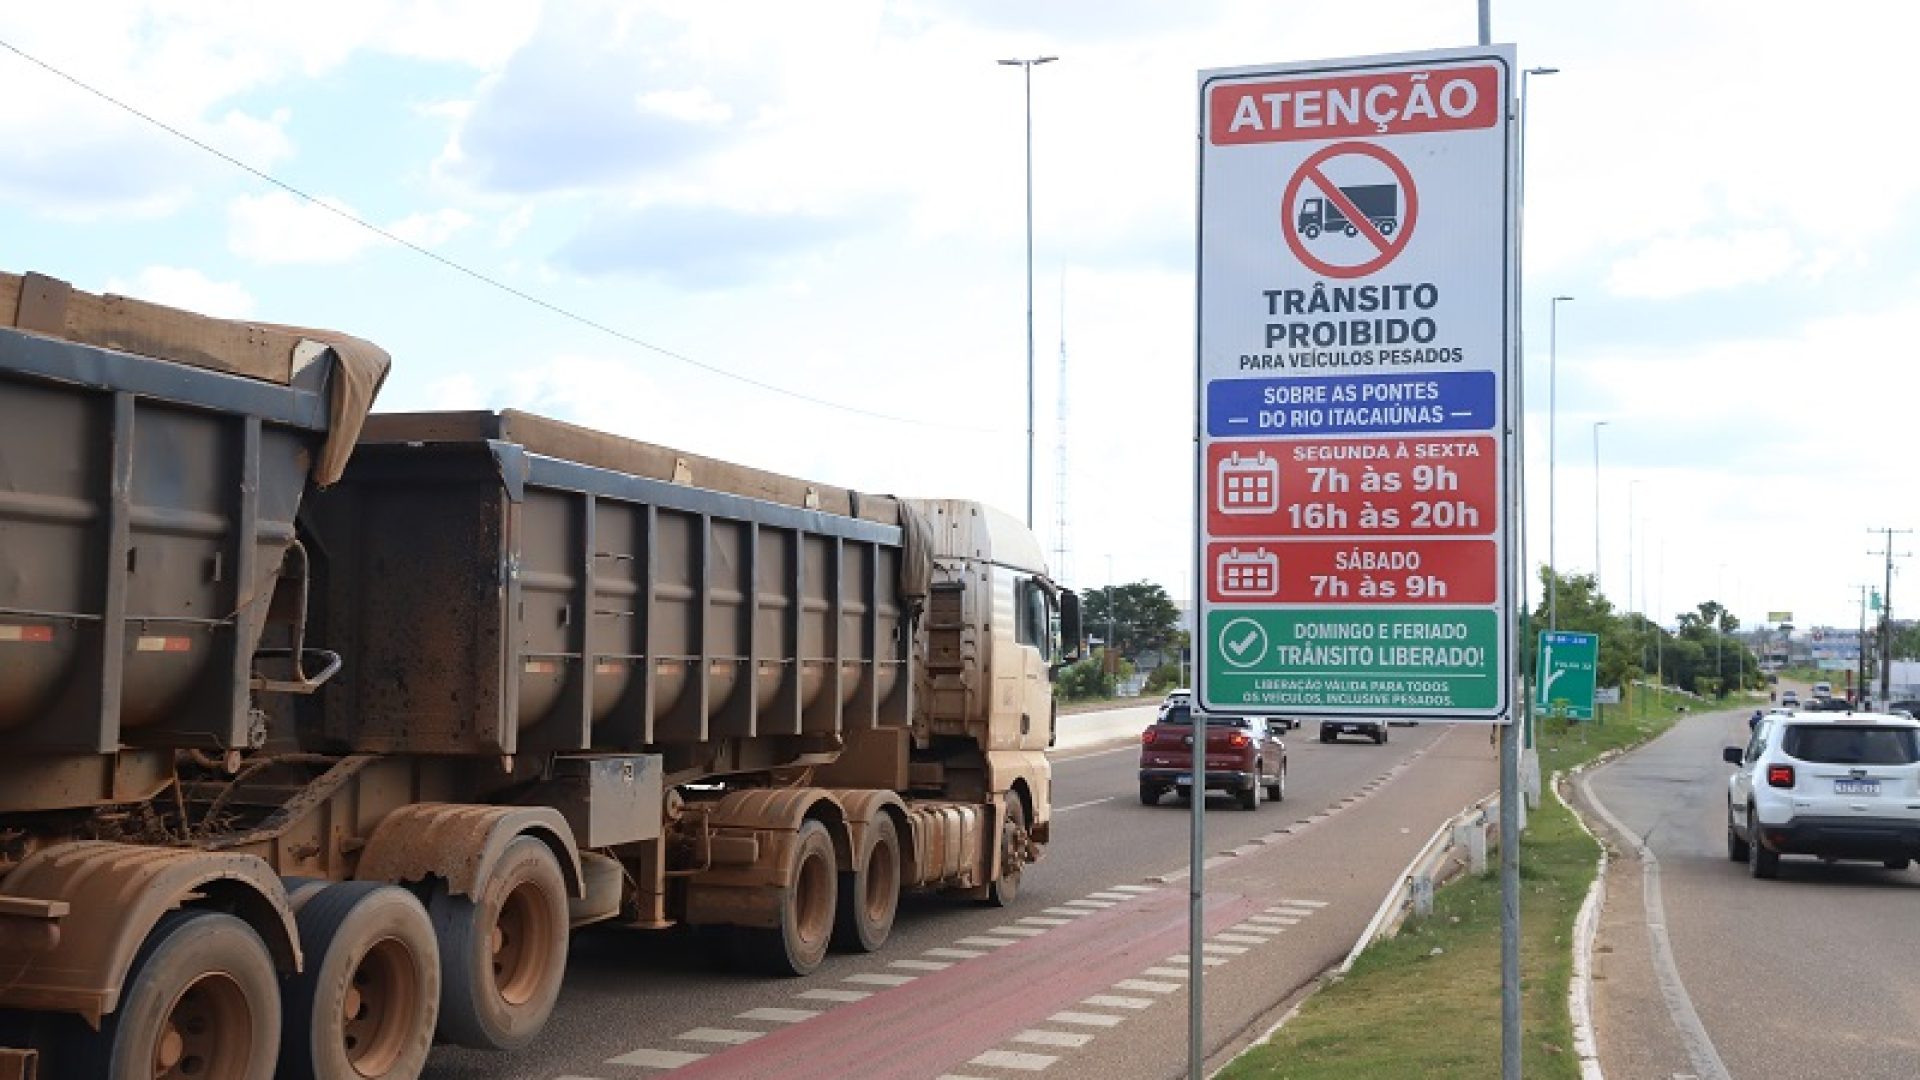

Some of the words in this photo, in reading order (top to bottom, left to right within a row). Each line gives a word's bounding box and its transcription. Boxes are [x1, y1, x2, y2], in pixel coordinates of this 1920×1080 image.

[1229, 72, 1478, 132] ATENÇÃO
[1263, 281, 1438, 314] TRÂNSITO
[1265, 317, 1437, 348] PROIBIDO
[1240, 353, 1284, 369] PARA
[1289, 349, 1374, 367] VEÍCULOS
[1379, 347, 1462, 365] PESADOS
[1264, 386, 1326, 404] SOBRE
[1331, 383, 1357, 401] AS
[1362, 381, 1439, 400] PONTES
[1259, 410, 1287, 427] DO
[1290, 408, 1323, 426] RIO
[1328, 403, 1444, 425] ITACAIÚNAS
[1293, 445, 1390, 461] SEGUNDA
[1396, 441, 1409, 459] À
[1415, 442, 1479, 458] SEXTA
[1307, 467, 1349, 493] 7h
[1361, 466, 1402, 493] às
[1413, 465, 1458, 491] 9h
[1288, 503, 1348, 529] 16h
[1360, 502, 1400, 529] às
[1411, 501, 1479, 528] 20h
[1335, 547, 1420, 570] SÁBADO
[1309, 576, 1349, 598] 7h
[1359, 574, 1397, 597] às
[1406, 575, 1447, 597] 9h
[1294, 623, 1375, 640] DOMINGO
[1380, 623, 1390, 639] E
[1394, 623, 1468, 640] FERIADO
[1277, 641, 1374, 666] TRÂNSITO
[1379, 646, 1485, 667] LIBERADO!
[1242, 691, 1259, 702] OS
[1254, 678, 1321, 691] LIBERAÇÃO
[1324, 680, 1368, 691] VÁLIDA
[1370, 681, 1404, 691] PARA
[1406, 681, 1448, 692] TODOS
